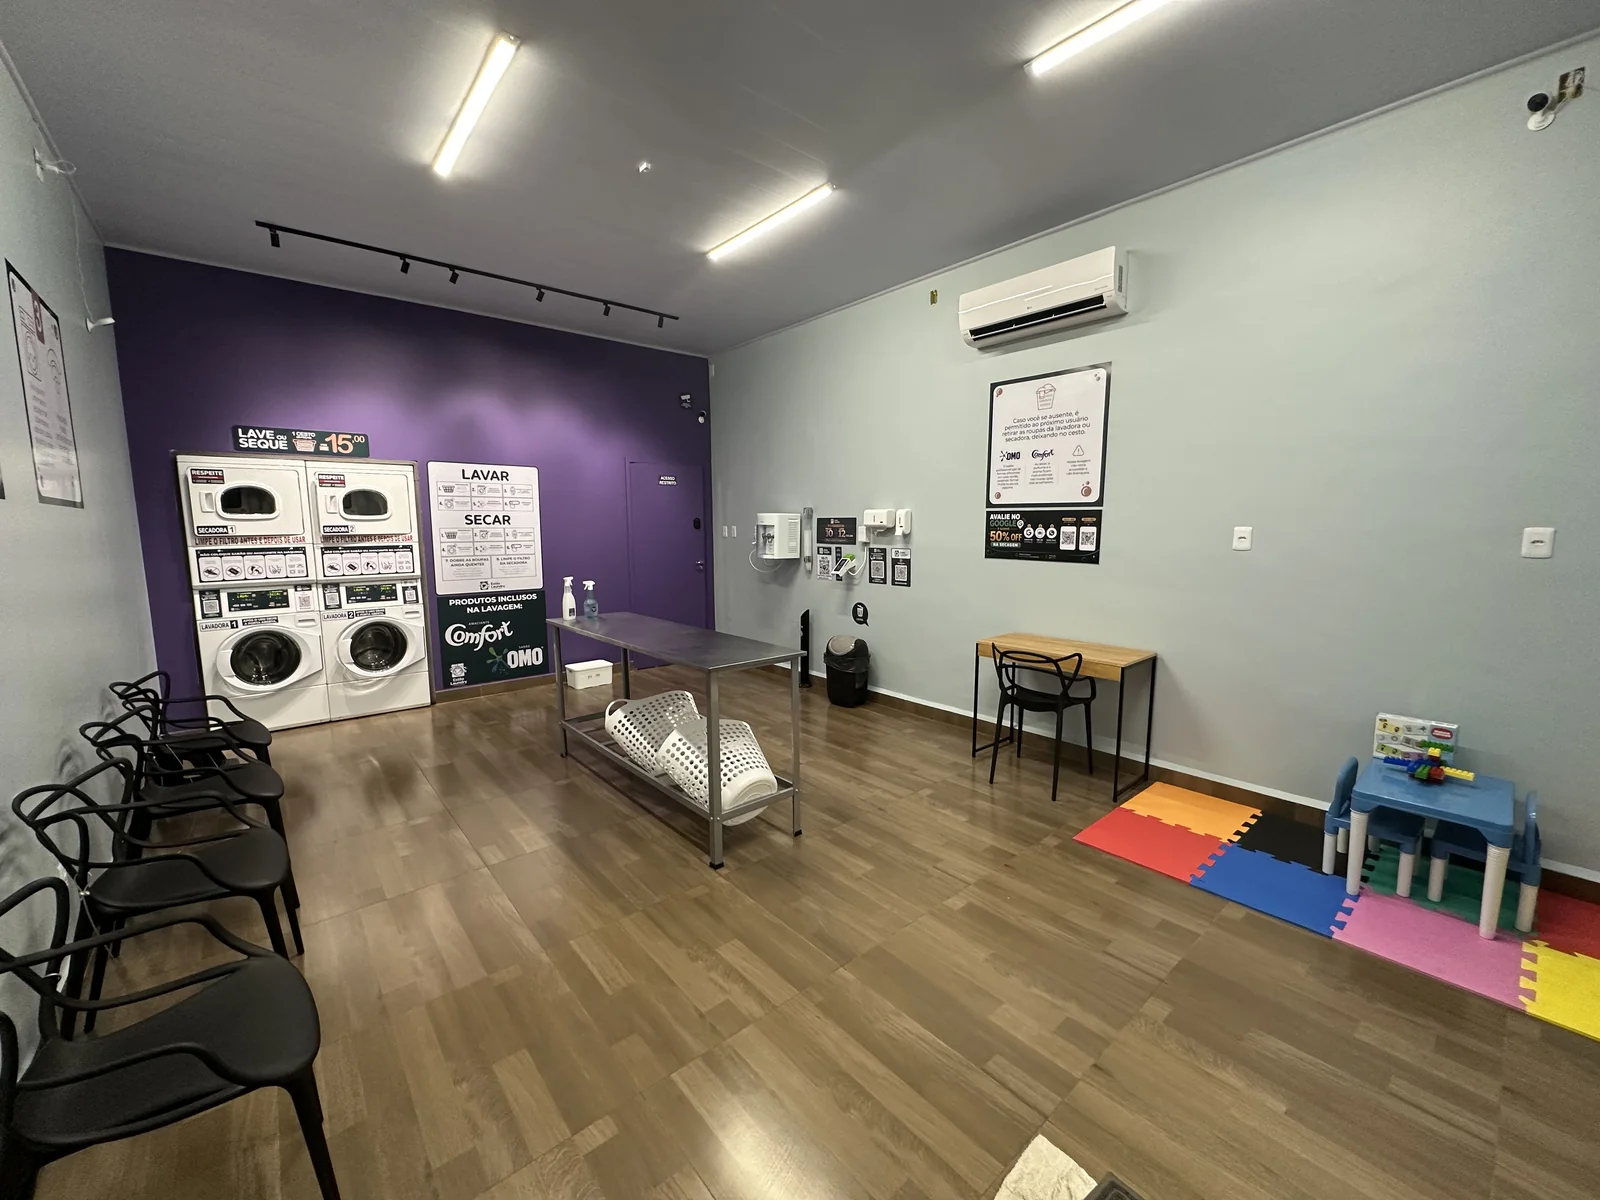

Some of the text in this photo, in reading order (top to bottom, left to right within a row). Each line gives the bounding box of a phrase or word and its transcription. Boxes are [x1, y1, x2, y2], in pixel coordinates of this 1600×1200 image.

[1040, 419, 1064, 427] próximo
[238, 428, 274, 439] LAVE
[239, 438, 288, 450] SEQUE
[1006, 452, 1020, 460] OMO
[1032, 449, 1054, 461] Comfort
[462, 469, 509, 481] LAVAR
[465, 514, 511, 525] SECAR
[990, 531, 1010, 541] 50%
[449, 594, 537, 606] PRODUTOS INCLUSOS
[482, 603, 523, 612] LAVAGEM:
[445, 621, 513, 651] Comfort
[507, 647, 543, 668] OMO
